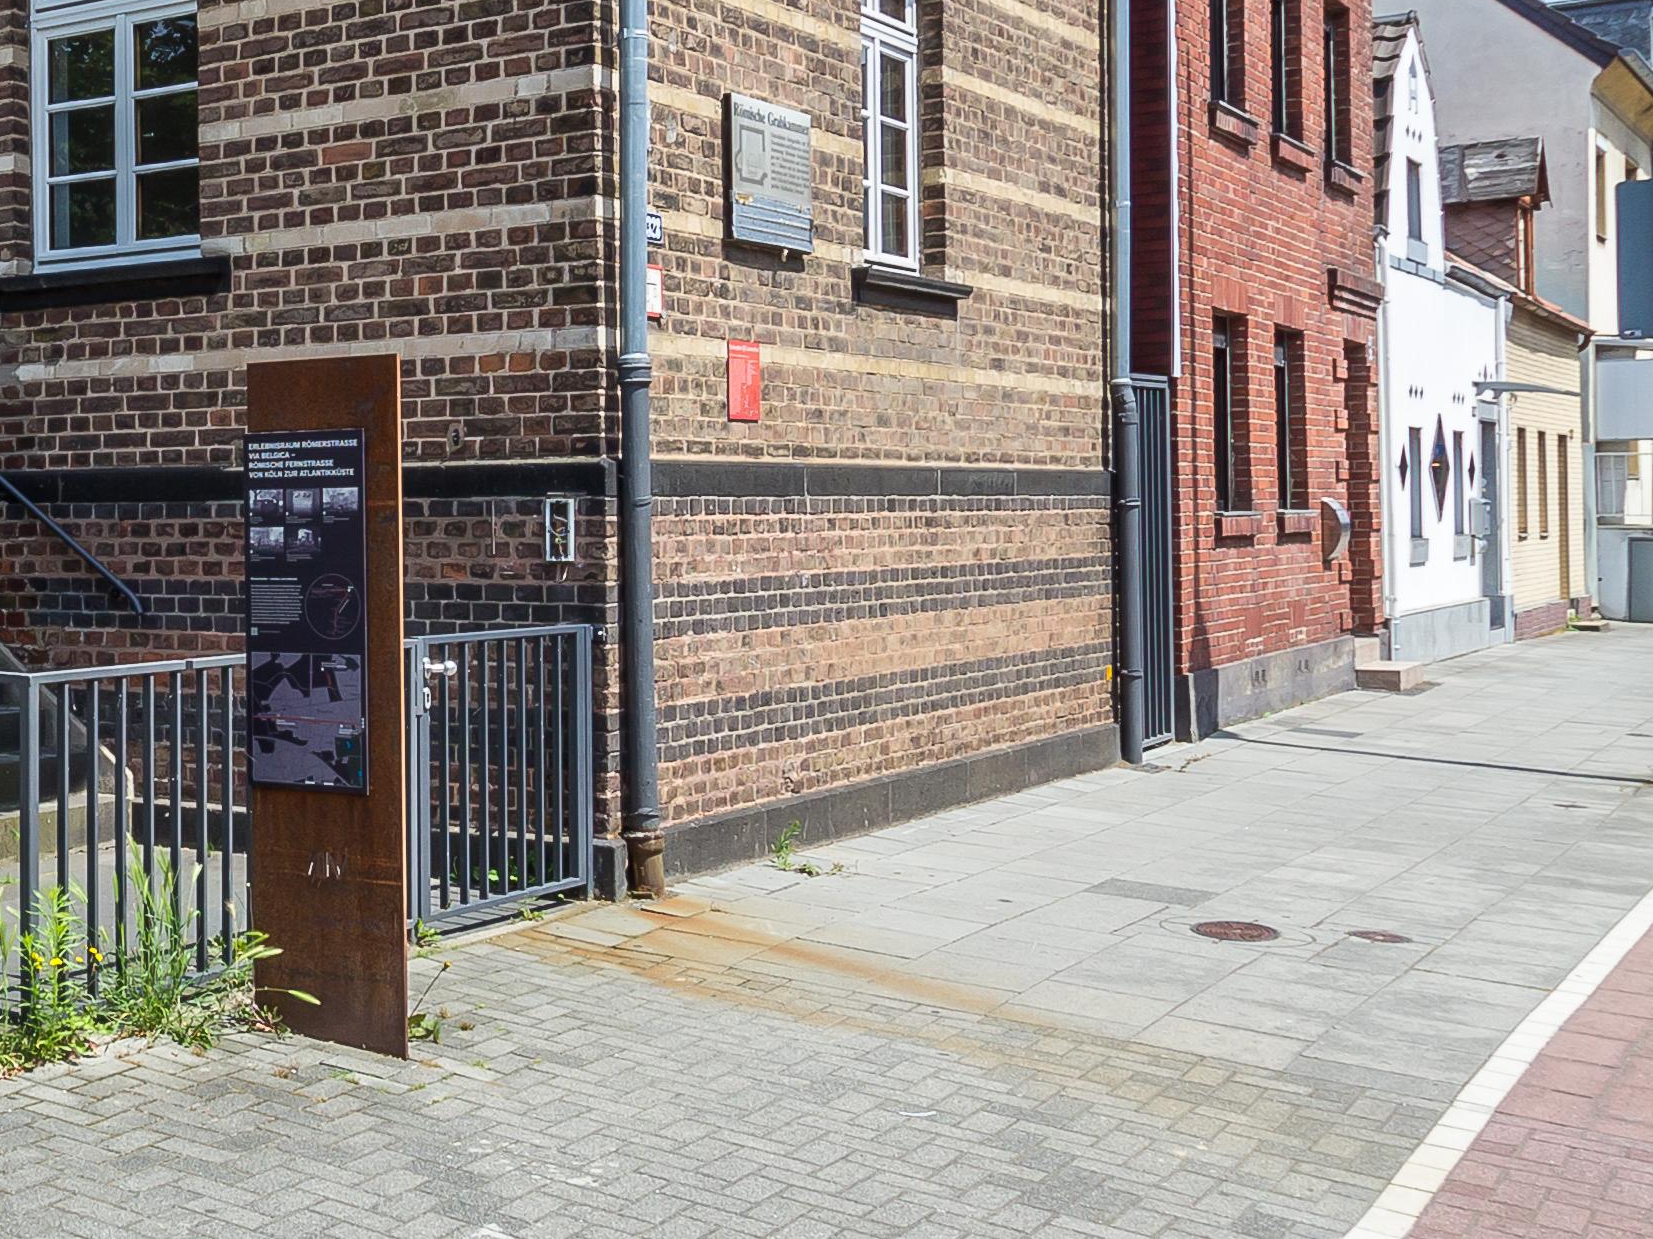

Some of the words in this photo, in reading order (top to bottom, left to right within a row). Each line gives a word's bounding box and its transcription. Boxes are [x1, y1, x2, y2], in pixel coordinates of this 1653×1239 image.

[733, 102, 765, 124] Römische
[248, 441, 300, 450] ERLEBNISRAUM
[302, 439, 357, 448] RÖMERSTRASSE
[285, 459, 334, 468] FERNSTRASSE
[264, 470, 283, 478] KÖLN
[299, 467, 354, 477] ATLANTIKKÜSTE
